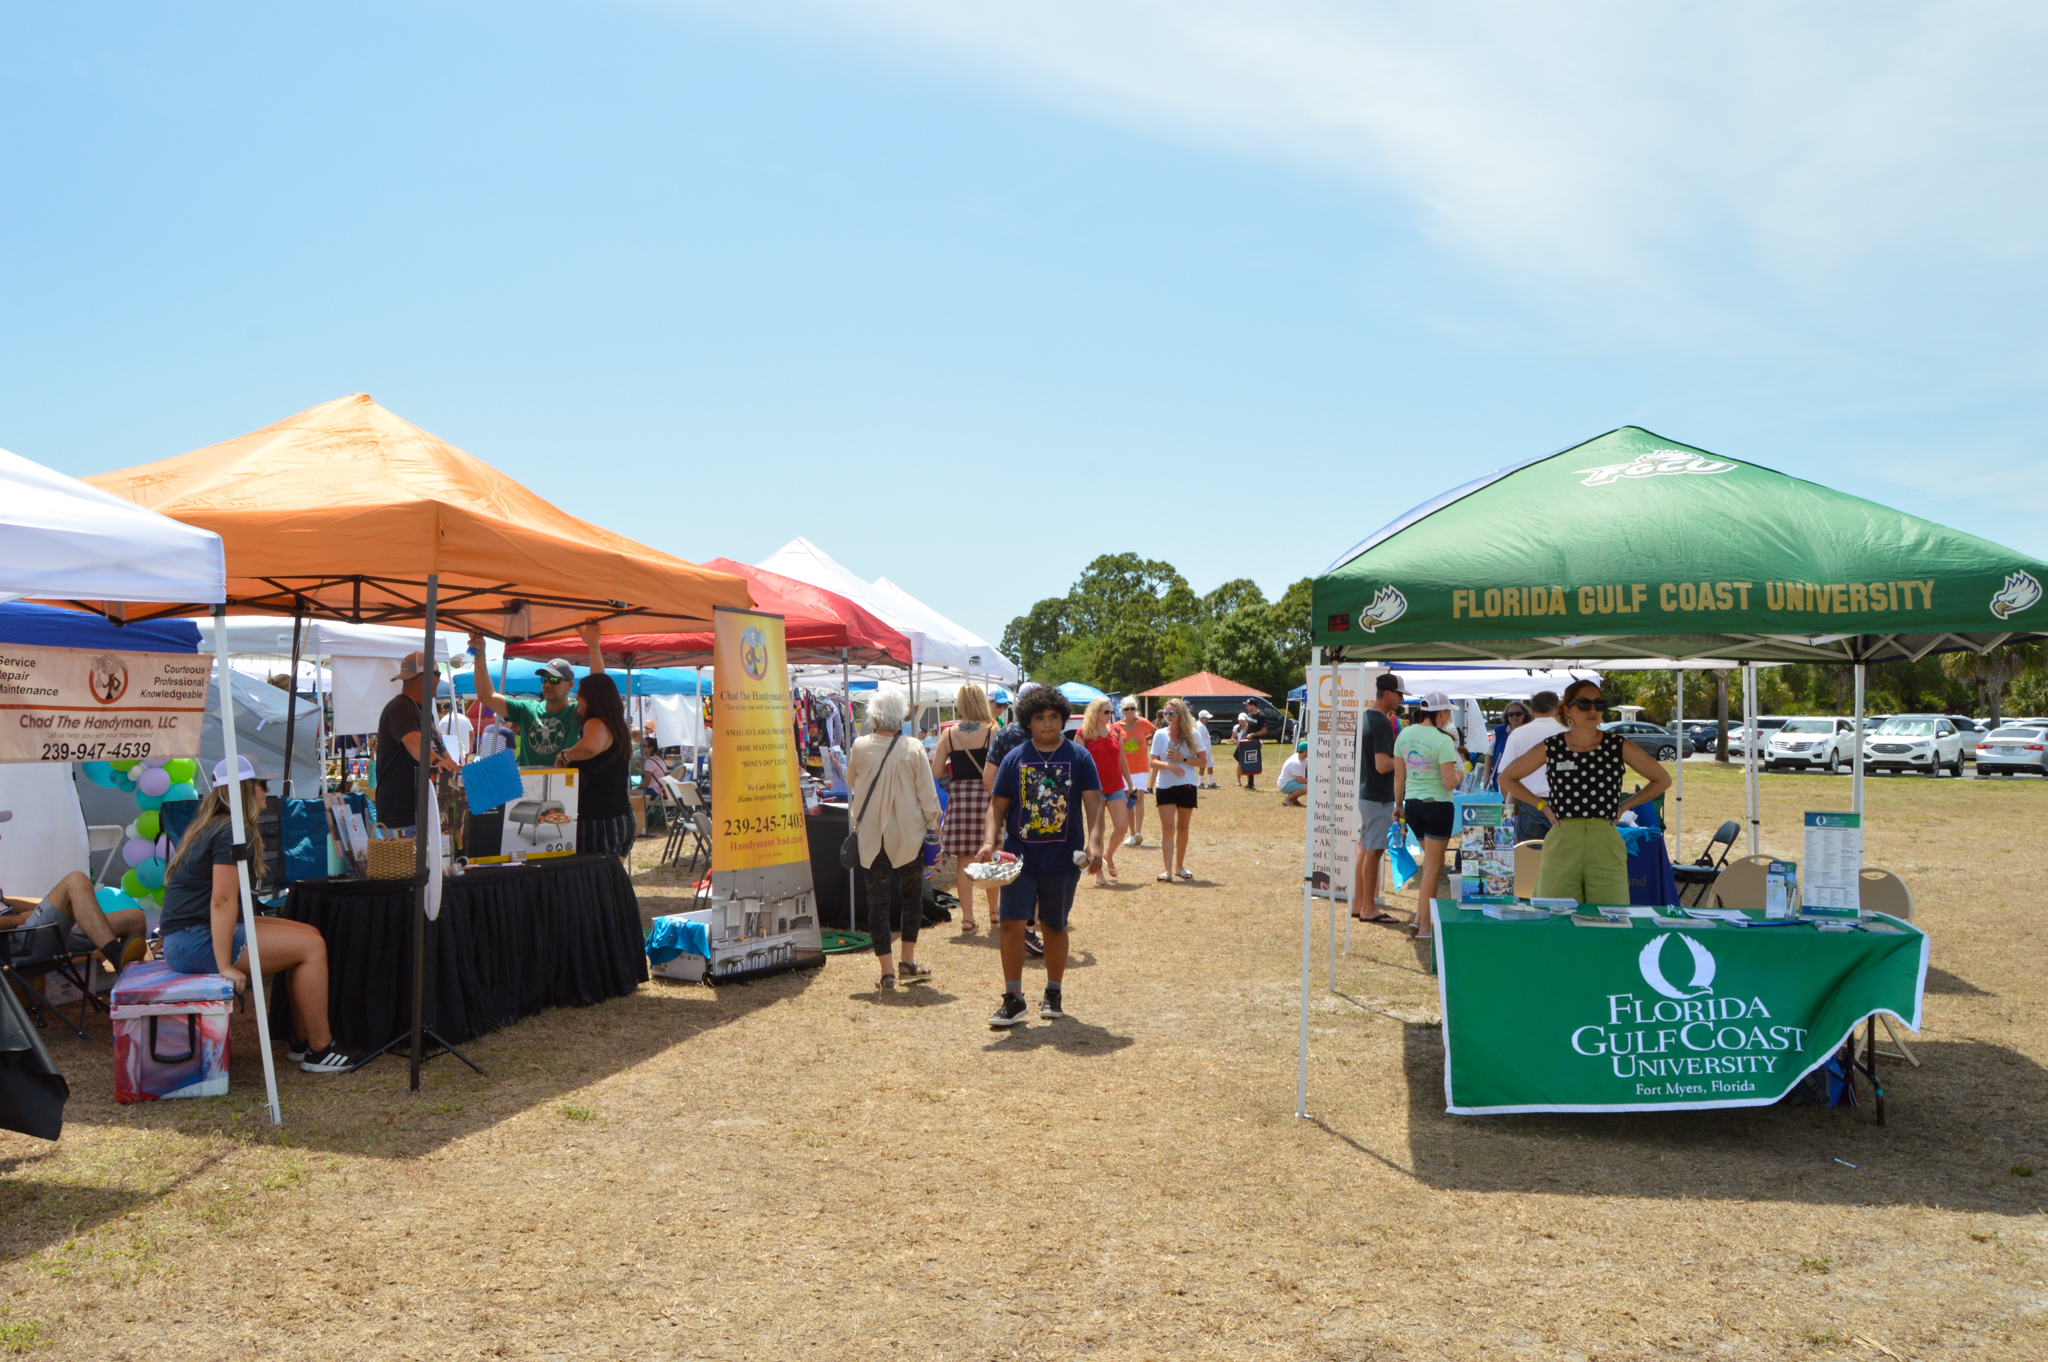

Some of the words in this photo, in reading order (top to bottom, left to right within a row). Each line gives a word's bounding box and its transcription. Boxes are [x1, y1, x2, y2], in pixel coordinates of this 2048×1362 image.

[1453, 587, 1566, 618] FLORIDA
[1578, 584, 1647, 615] GULF
[1660, 582, 1752, 612] COAST
[1766, 580, 1935, 614] UNIVERSITY
[0, 655, 36, 668] Service
[164, 664, 205, 674] Courteous
[154, 676, 204, 686] Professional
[140, 689, 203, 700] Knowledgeable
[720, 690, 738, 700] Chad
[740, 691, 750, 700] The
[753, 691, 782, 703] Handyman
[20, 714, 54, 728] Chad
[57, 716, 80, 728] The
[84, 716, 154, 731] Handyman,
[158, 716, 178, 728] LLC
[41, 742, 151, 760] 239-947-4539
[753, 743, 788, 751] MAINTENANCE
[468, 762, 500, 794] WIN
[766, 783, 776, 791] Help
[754, 793, 777, 802] Inspection
[723, 812, 804, 836] 239-245-7403
[730, 836, 803, 851] HandymanChad.com
[1606, 993, 1771, 1024] FLORIDA
[1611, 1054, 1777, 1078] UNIVERSITY
[1636, 1083, 1662, 1096] Fort
[1666, 1083, 1707, 1098] Myers,
[1711, 1080, 1756, 1093] Florida
